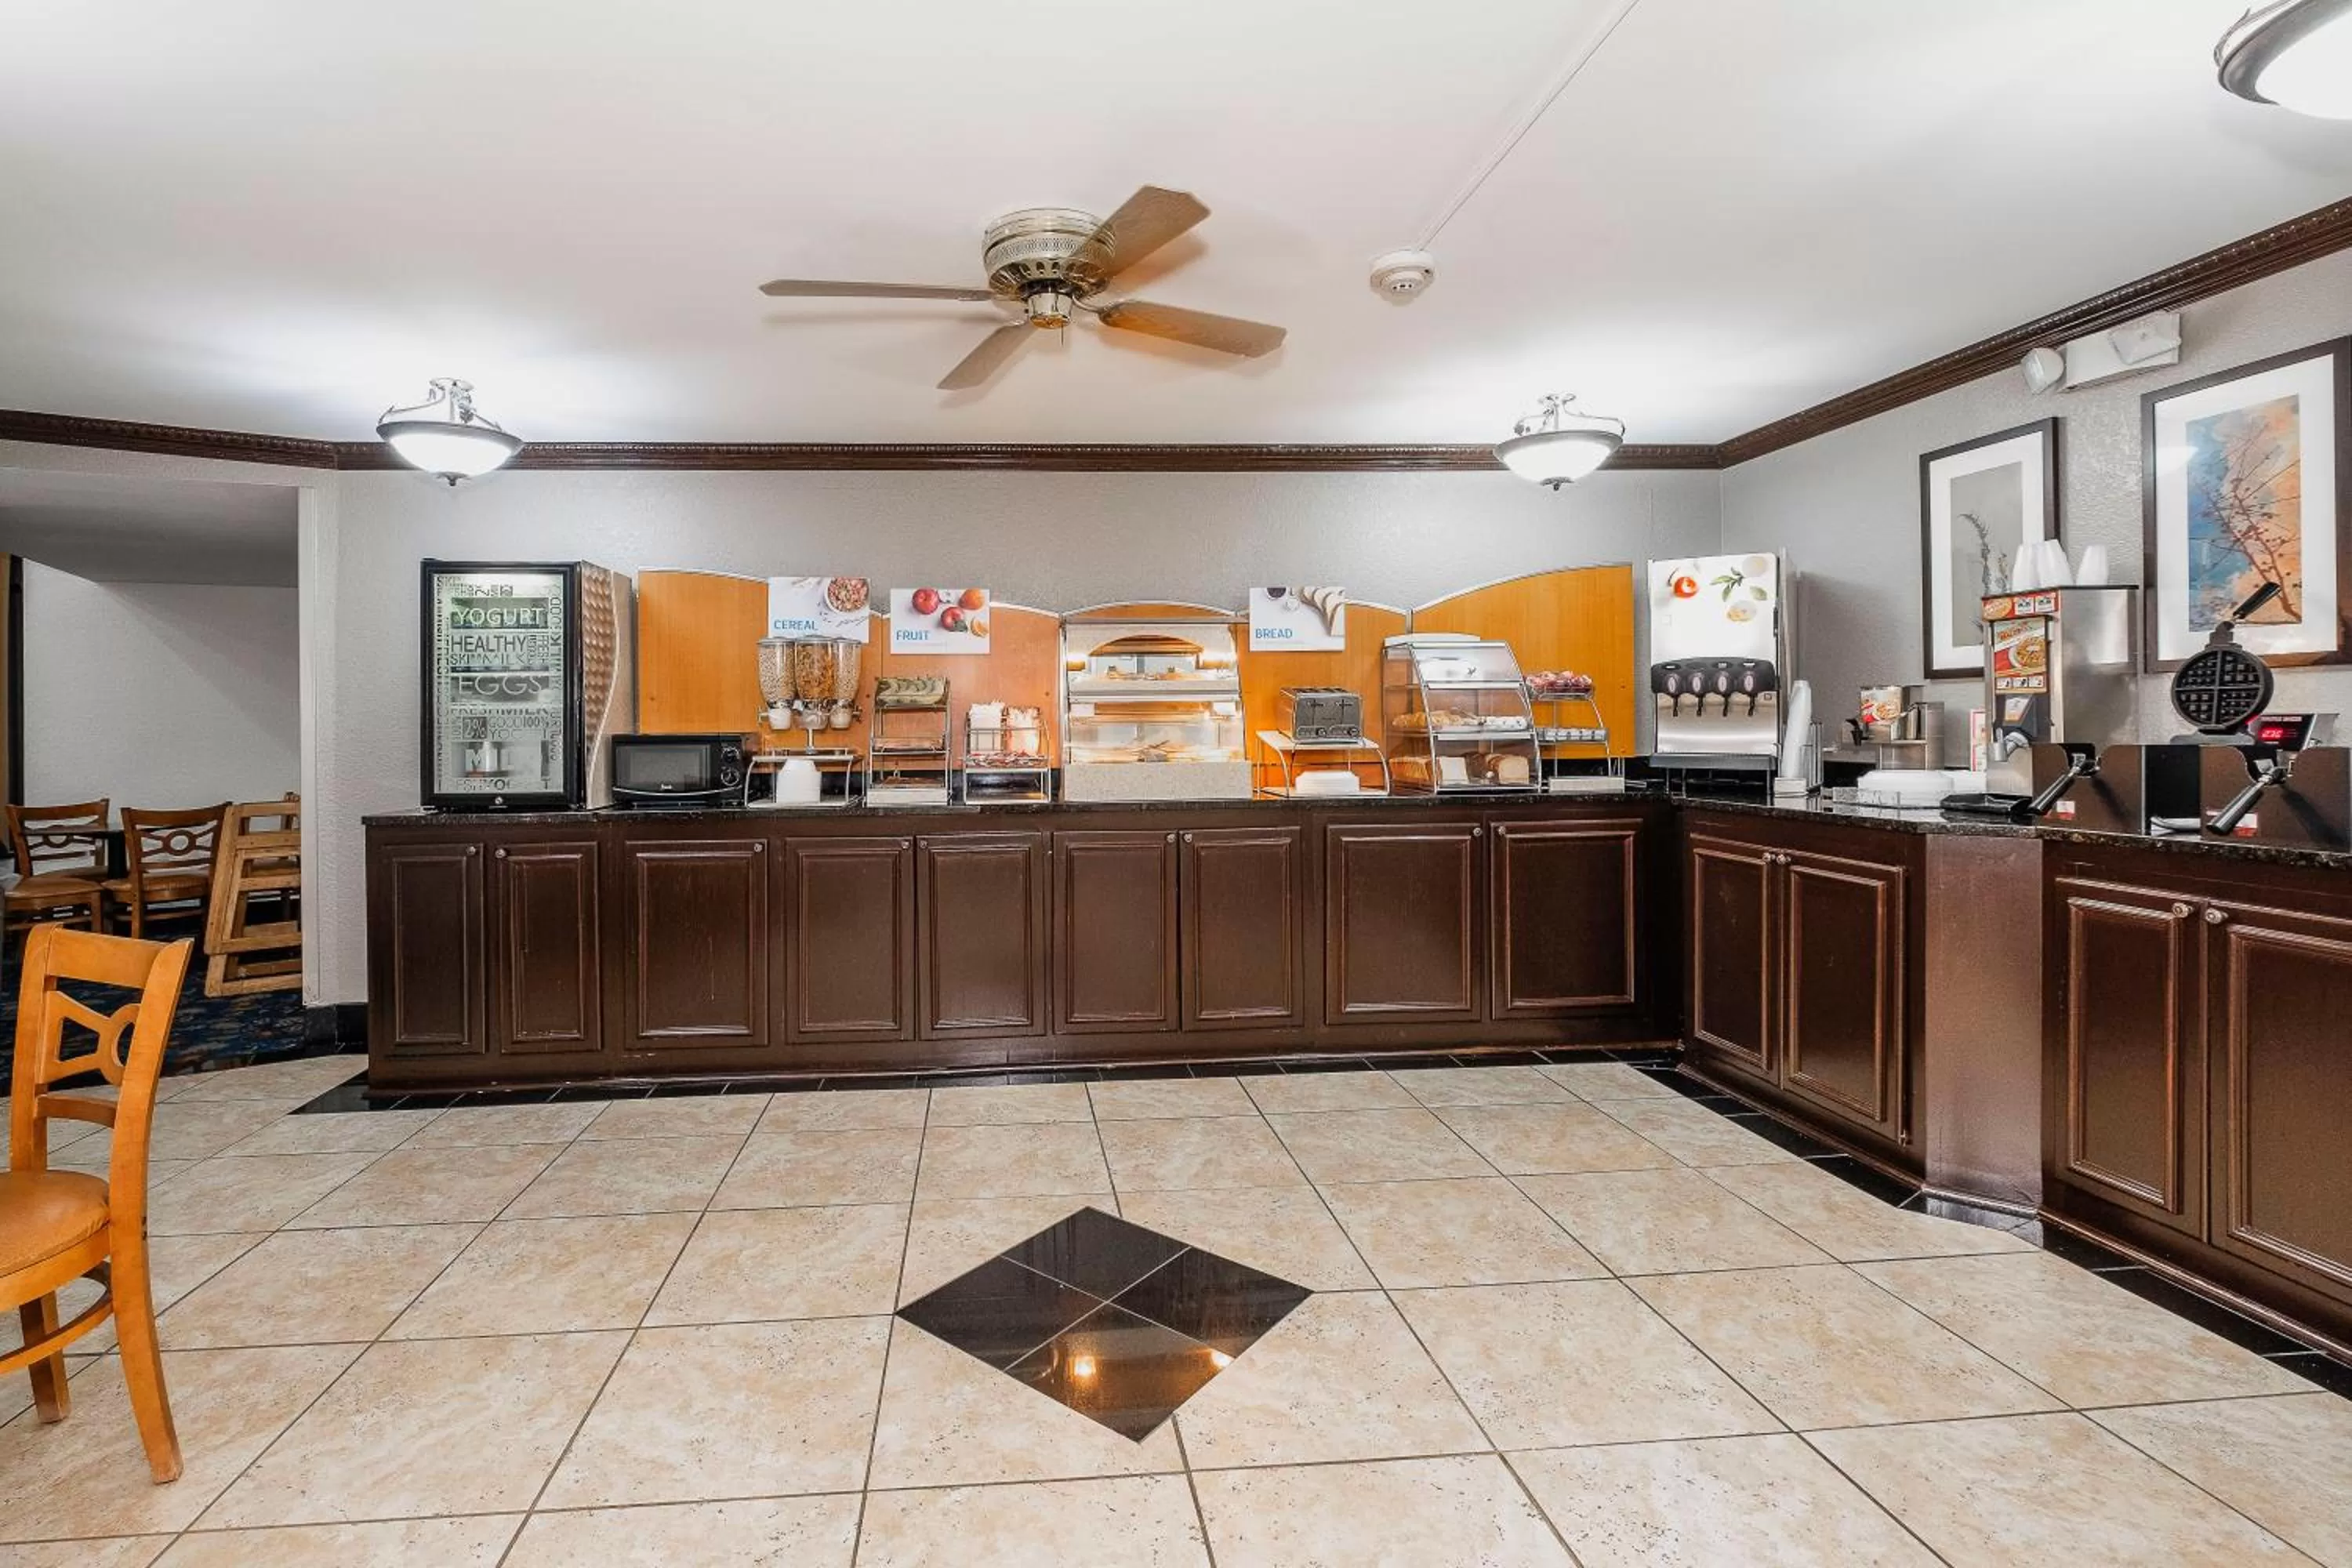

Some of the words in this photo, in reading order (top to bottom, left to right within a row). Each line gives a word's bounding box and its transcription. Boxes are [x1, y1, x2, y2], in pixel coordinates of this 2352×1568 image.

[456, 608, 543, 625] YOGURT
[774, 619, 818, 631] CEREAL
[896, 630, 931, 641] FRUIT
[1255, 628, 1293, 639] BREAD
[451, 635, 526, 652] HEALTHY
[459, 676, 542, 695] EGGS
